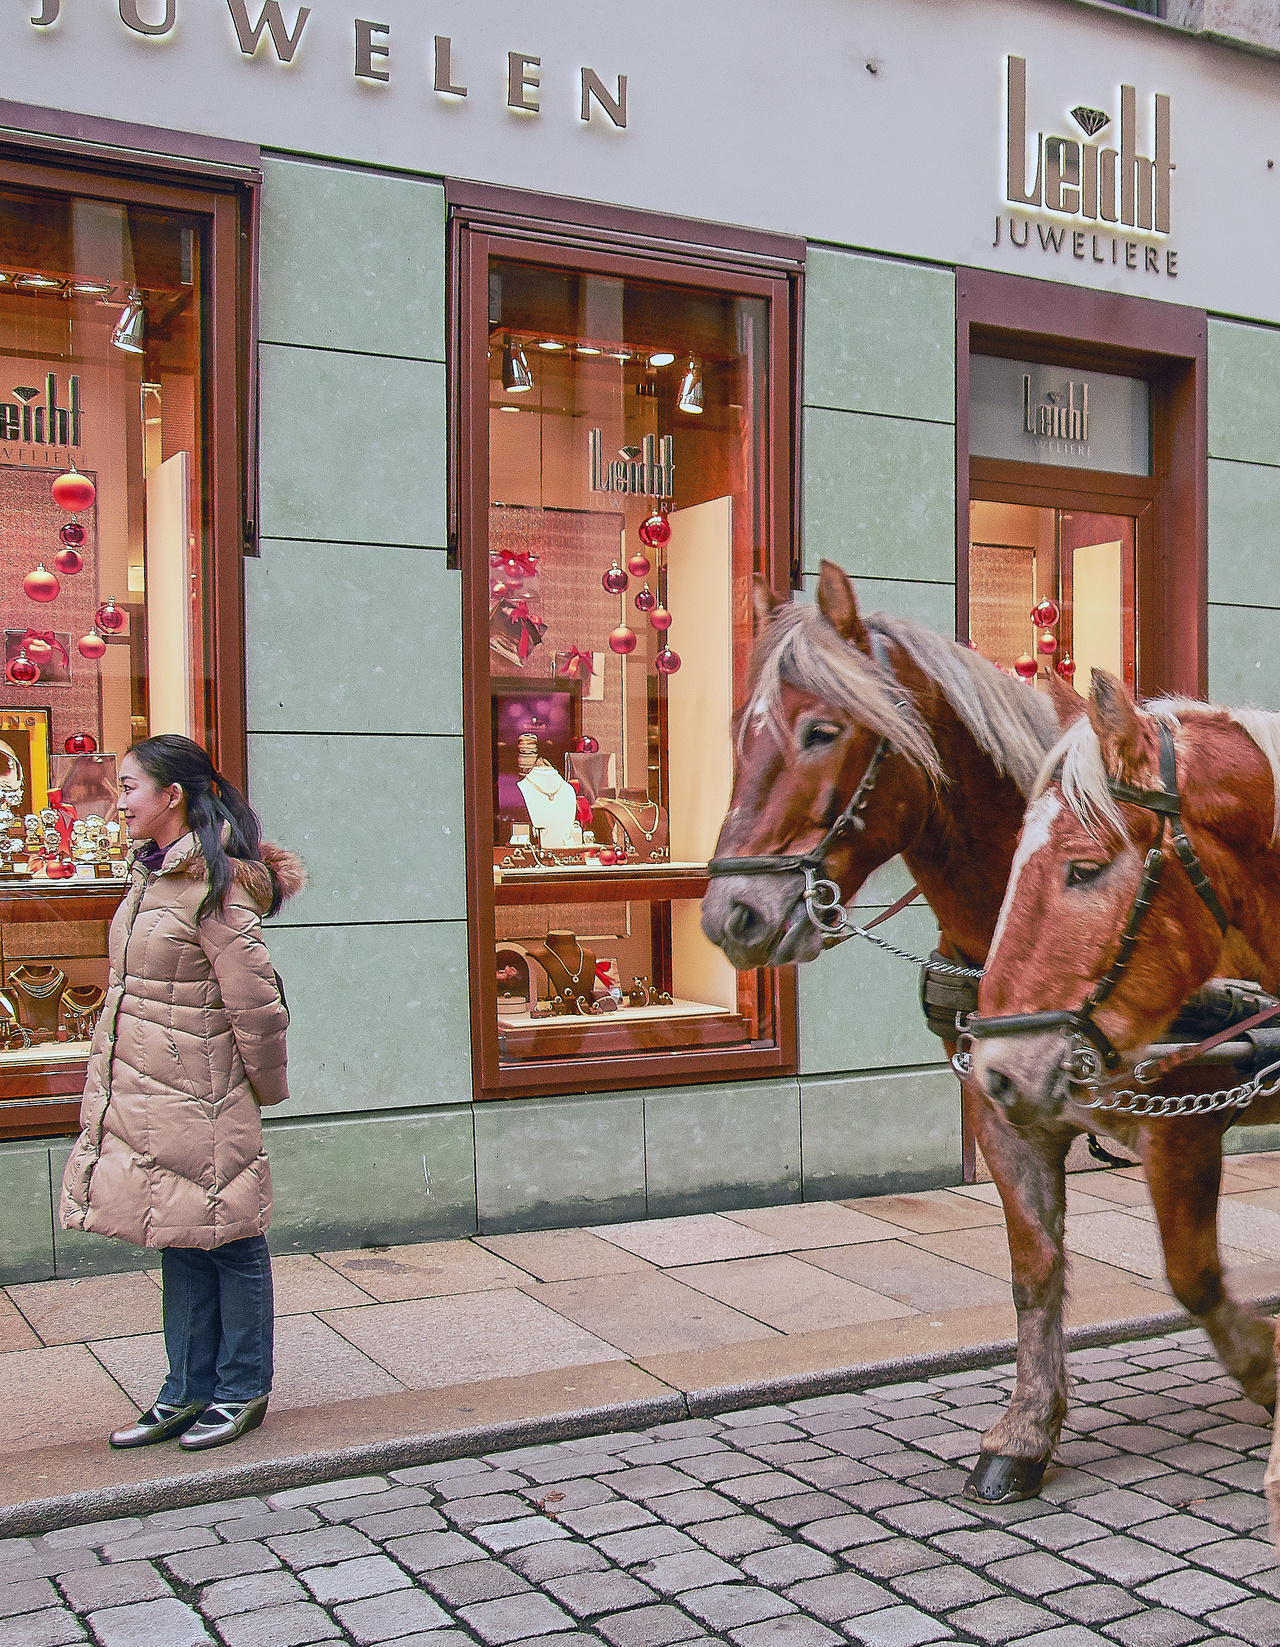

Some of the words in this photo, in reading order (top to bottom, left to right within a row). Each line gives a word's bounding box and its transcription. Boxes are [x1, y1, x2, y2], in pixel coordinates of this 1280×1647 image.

[1005, 54, 1178, 235] Leicht
[992, 215, 1179, 278] JUWELIERE
[1022, 373, 1090, 441] Leicht
[588, 427, 676, 499] Leicht
